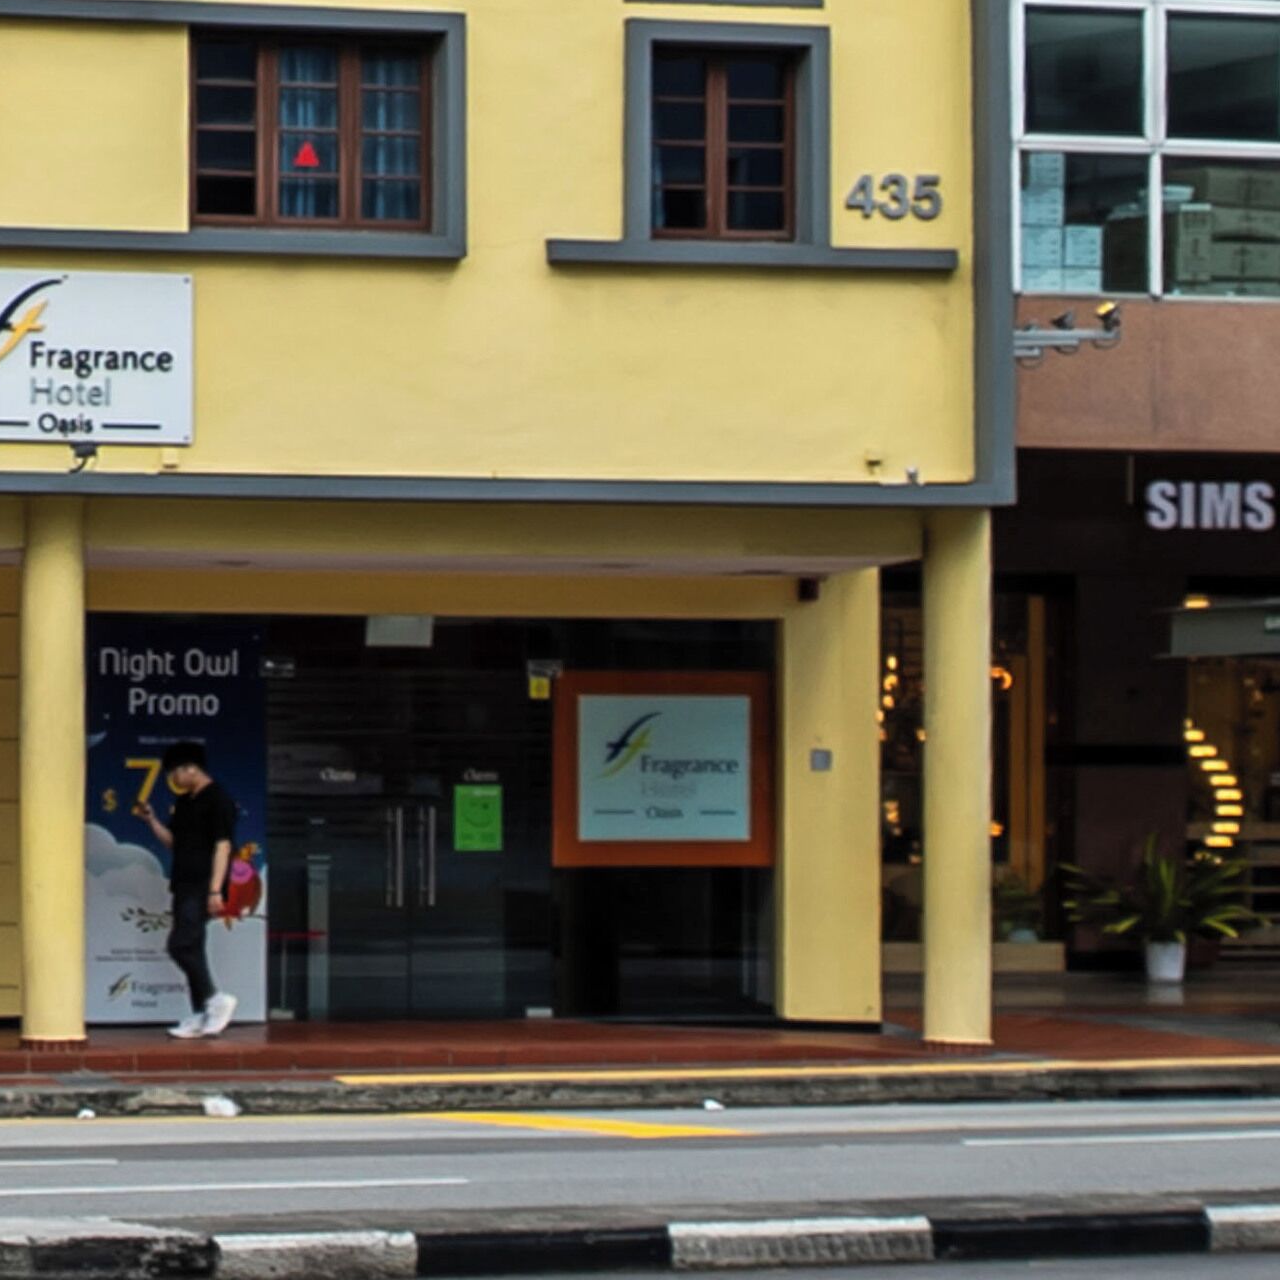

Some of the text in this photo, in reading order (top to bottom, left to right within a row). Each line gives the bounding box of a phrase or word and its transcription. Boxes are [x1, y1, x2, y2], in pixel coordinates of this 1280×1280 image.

[845, 173, 942, 221] 435
[30, 340, 174, 379] Fragrance
[30, 377, 112, 407] Hotel
[37, 412, 94, 436] Oasis
[1146, 480, 1275, 530] SIMS
[100, 647, 176, 682] Night
[184, 648, 239, 677] Owl
[127, 687, 220, 716] Promo
[640, 754, 740, 780] Fragrance
